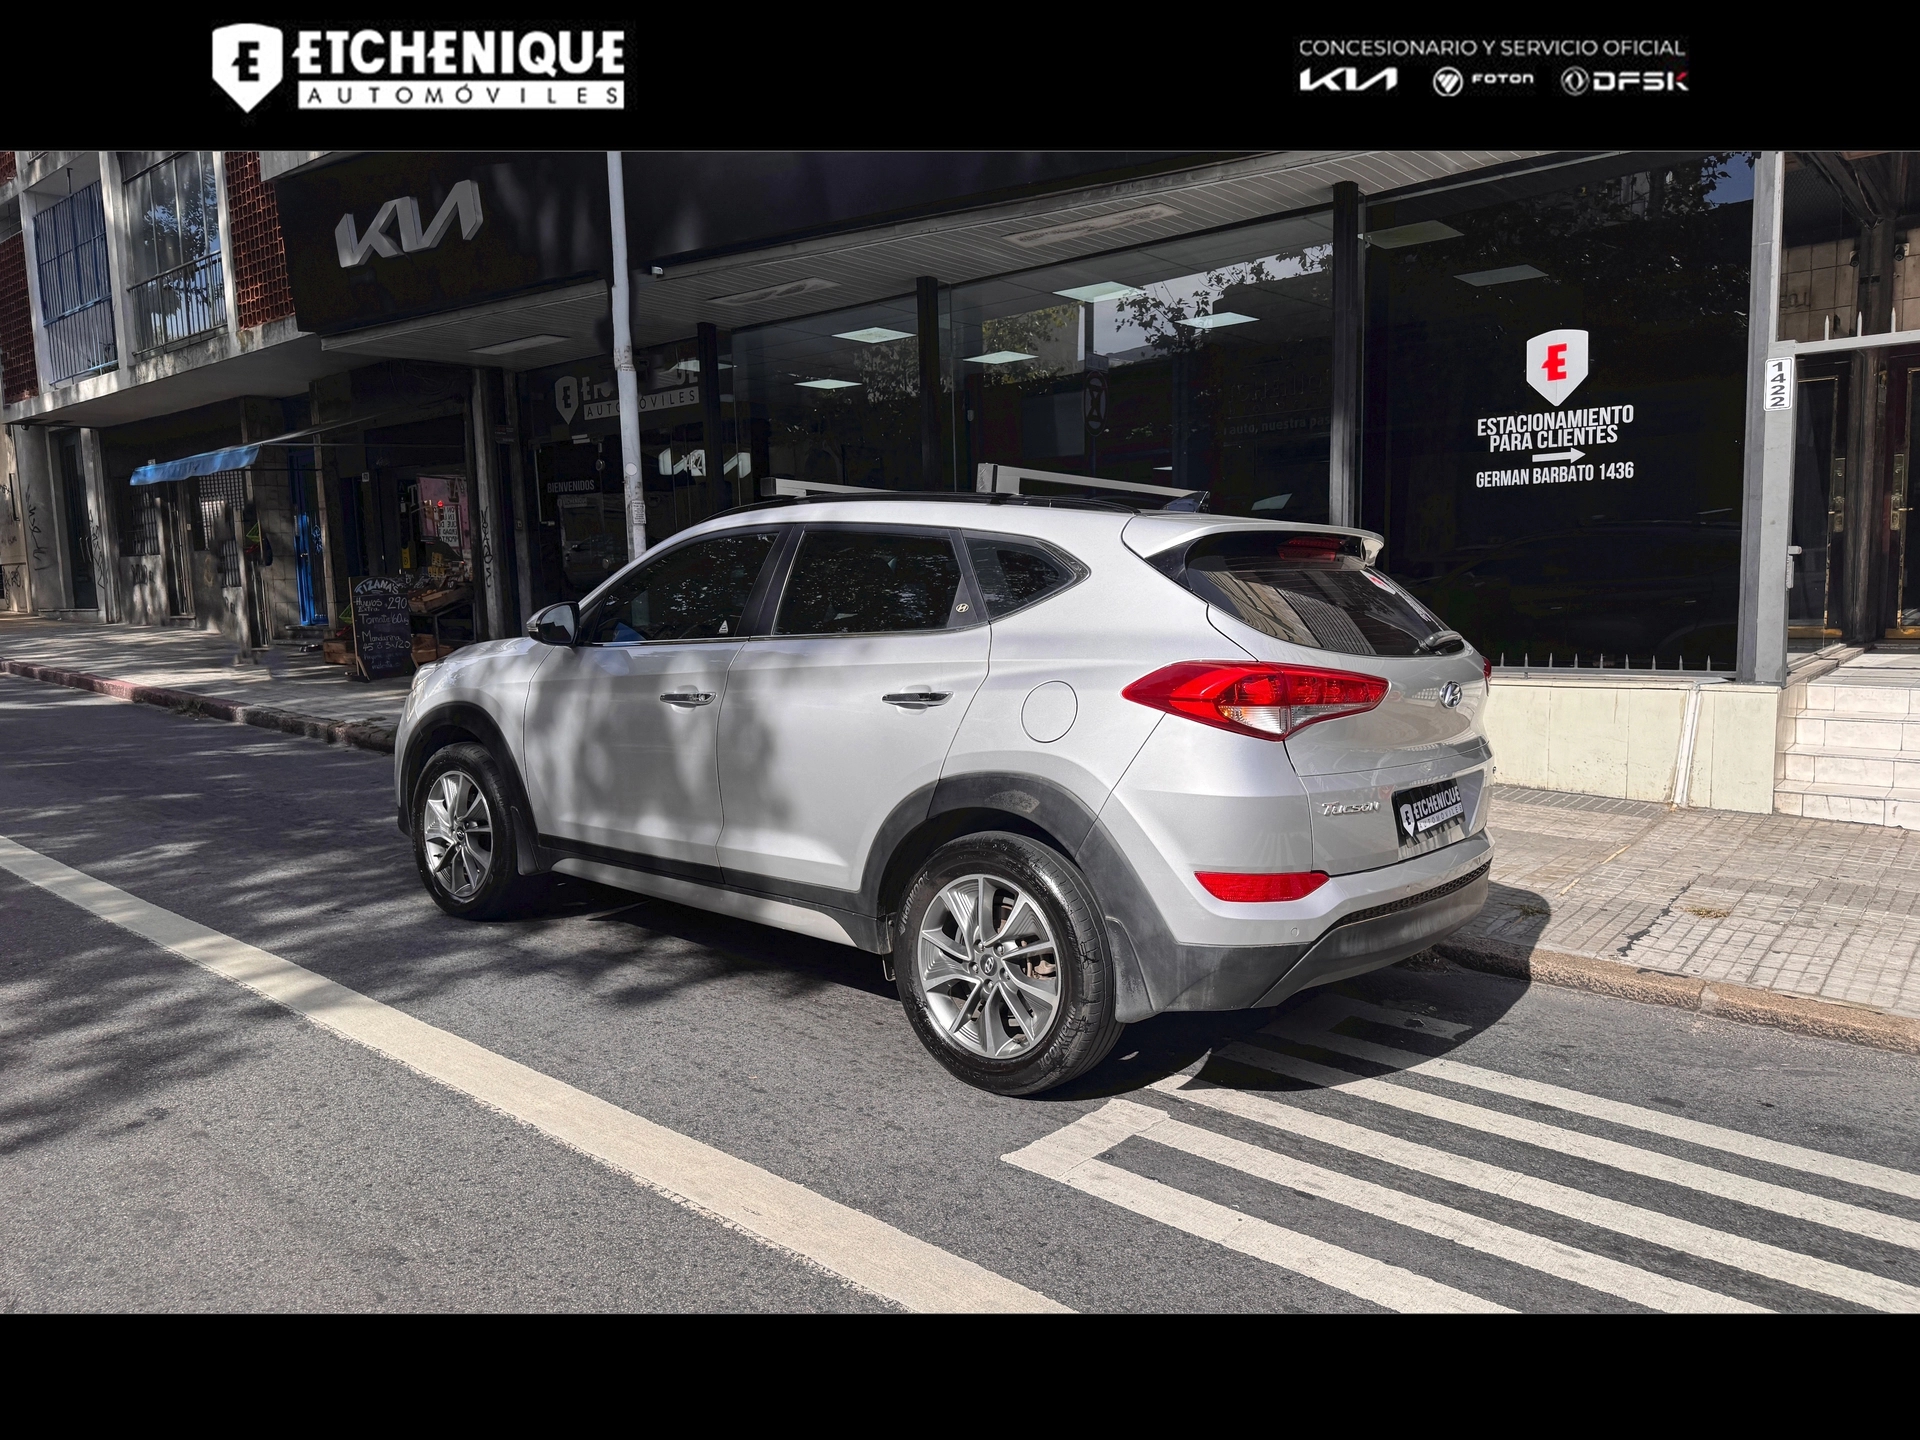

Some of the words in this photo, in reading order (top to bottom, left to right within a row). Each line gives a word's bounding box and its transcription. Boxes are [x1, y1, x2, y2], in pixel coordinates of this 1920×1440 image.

[334, 179, 483, 269] KIA
[1770, 361, 1787, 407] 1422
[587, 390, 695, 417] AUTOÓVILES
[1261, 416, 1307, 432] nuestra
[1477, 404, 1634, 436] ESTACIONAMIENTO
[1489, 432, 1533, 453] PARA
[1537, 424, 1618, 449] CLIENTES
[547, 479, 595, 493] BIENVENIDOS
[1476, 468, 1530, 488] GERMAN
[1533, 464, 1594, 484] BARBATO
[1599, 461, 1634, 481] 1436
[355, 578, 400, 595] TIZANA'S
[1412, 785, 1461, 820] ETCHENIQUE
